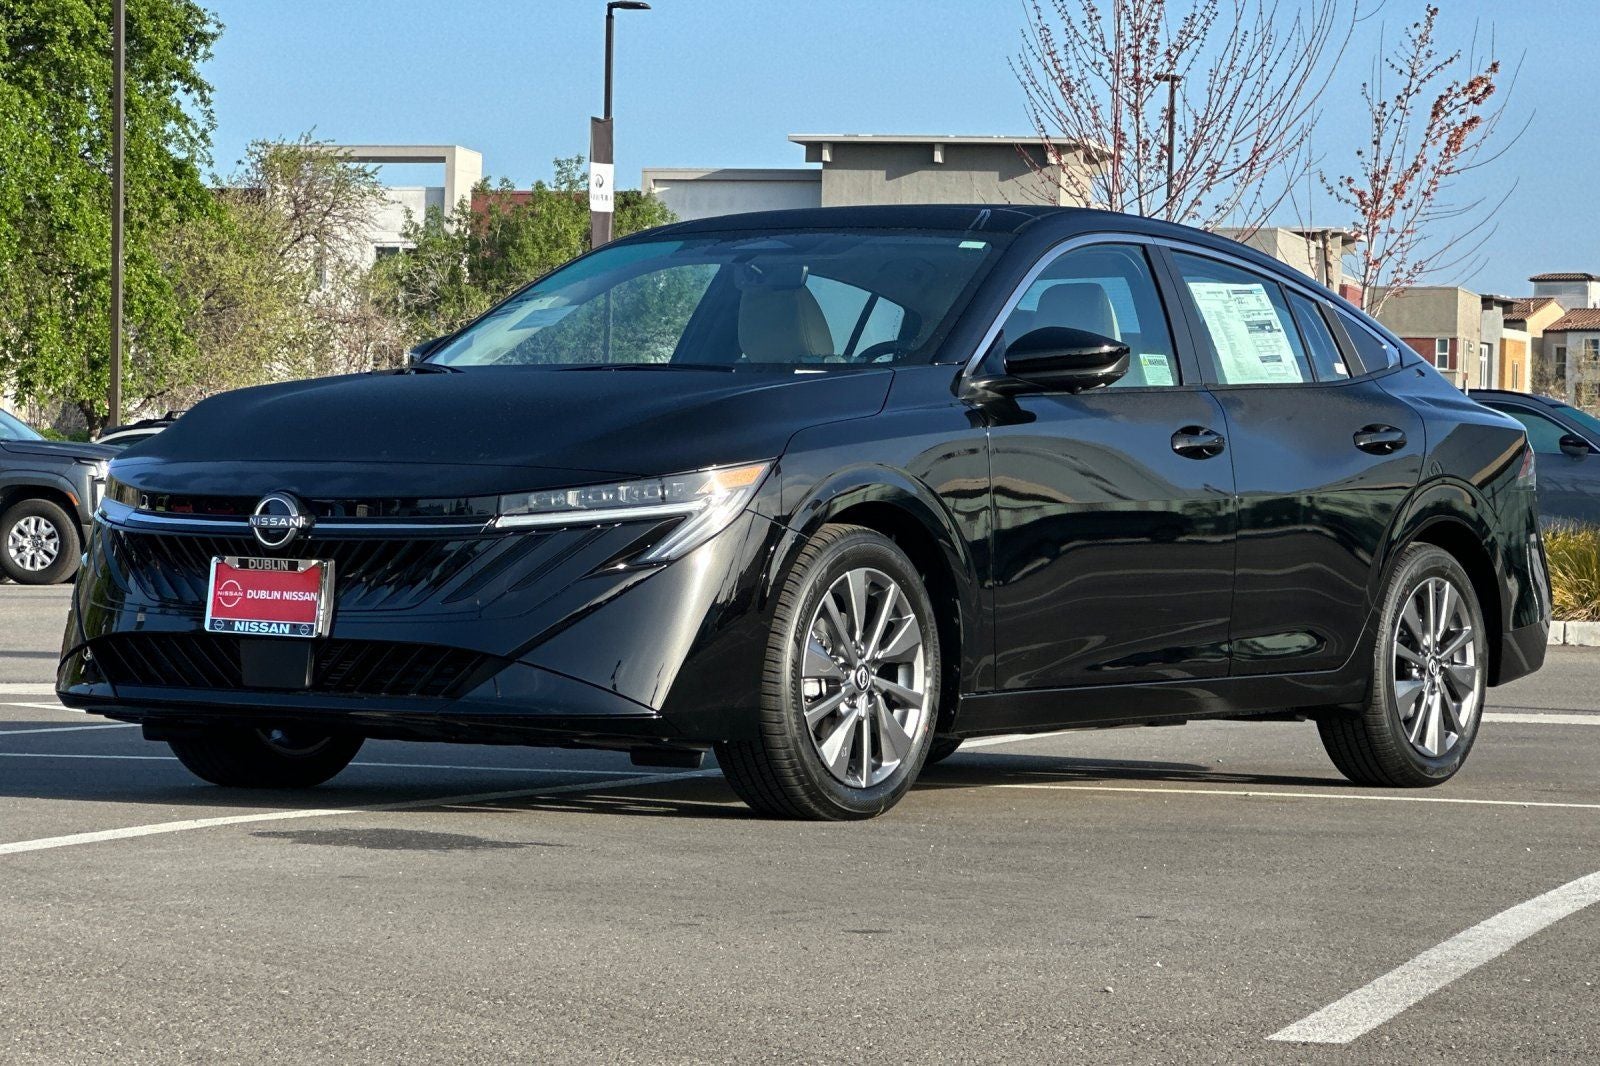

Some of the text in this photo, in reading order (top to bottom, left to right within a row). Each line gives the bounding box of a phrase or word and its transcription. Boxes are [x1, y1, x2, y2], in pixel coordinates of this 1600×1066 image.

[250, 517, 299, 527] NISSAN
[248, 559, 289, 571] DUBLIN
[246, 589, 317, 602] DUBLIN NISSAN
[234, 621, 290, 634] NISSAN
